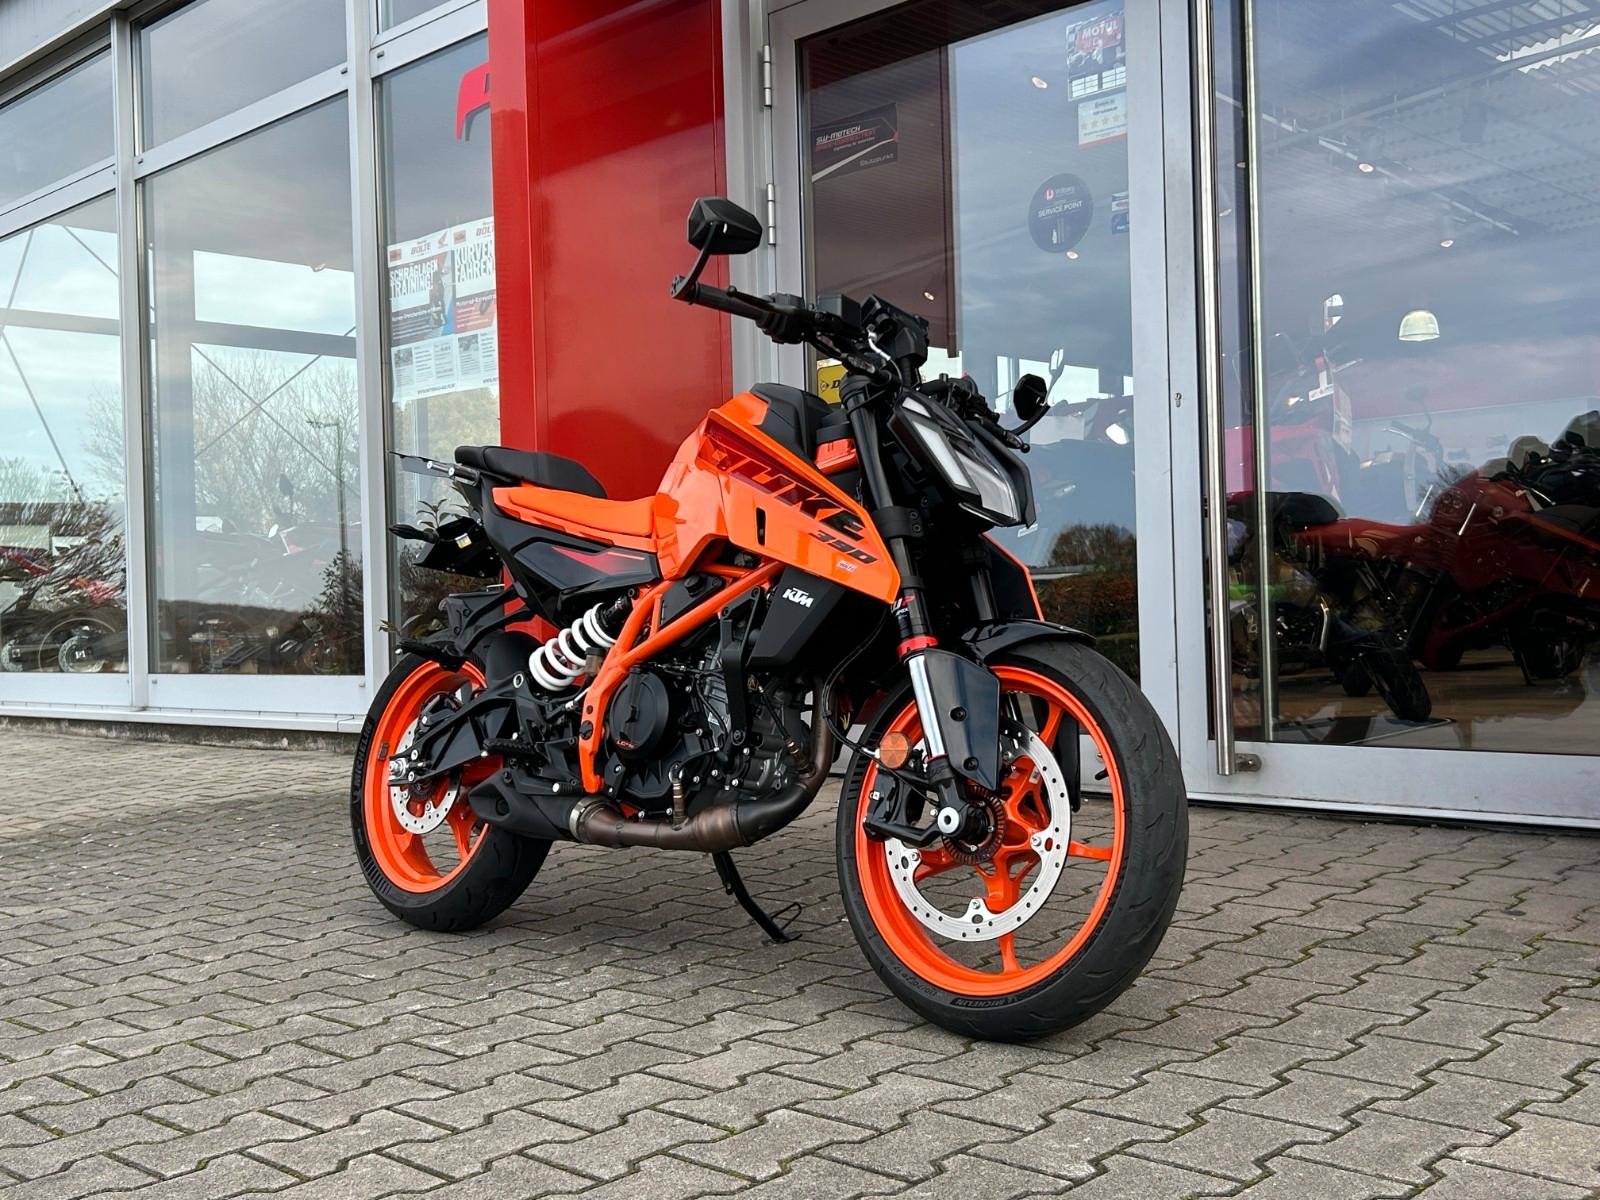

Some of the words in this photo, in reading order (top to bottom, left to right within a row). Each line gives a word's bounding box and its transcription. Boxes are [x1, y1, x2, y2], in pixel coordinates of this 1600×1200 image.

[1082, 20, 1119, 39] MOTUL
[1037, 206, 1063, 218] SERVICE
[1063, 200, 1083, 211] POINT
[782, 587, 814, 608] KTM
[955, 997, 1006, 1008] MICHELIN
